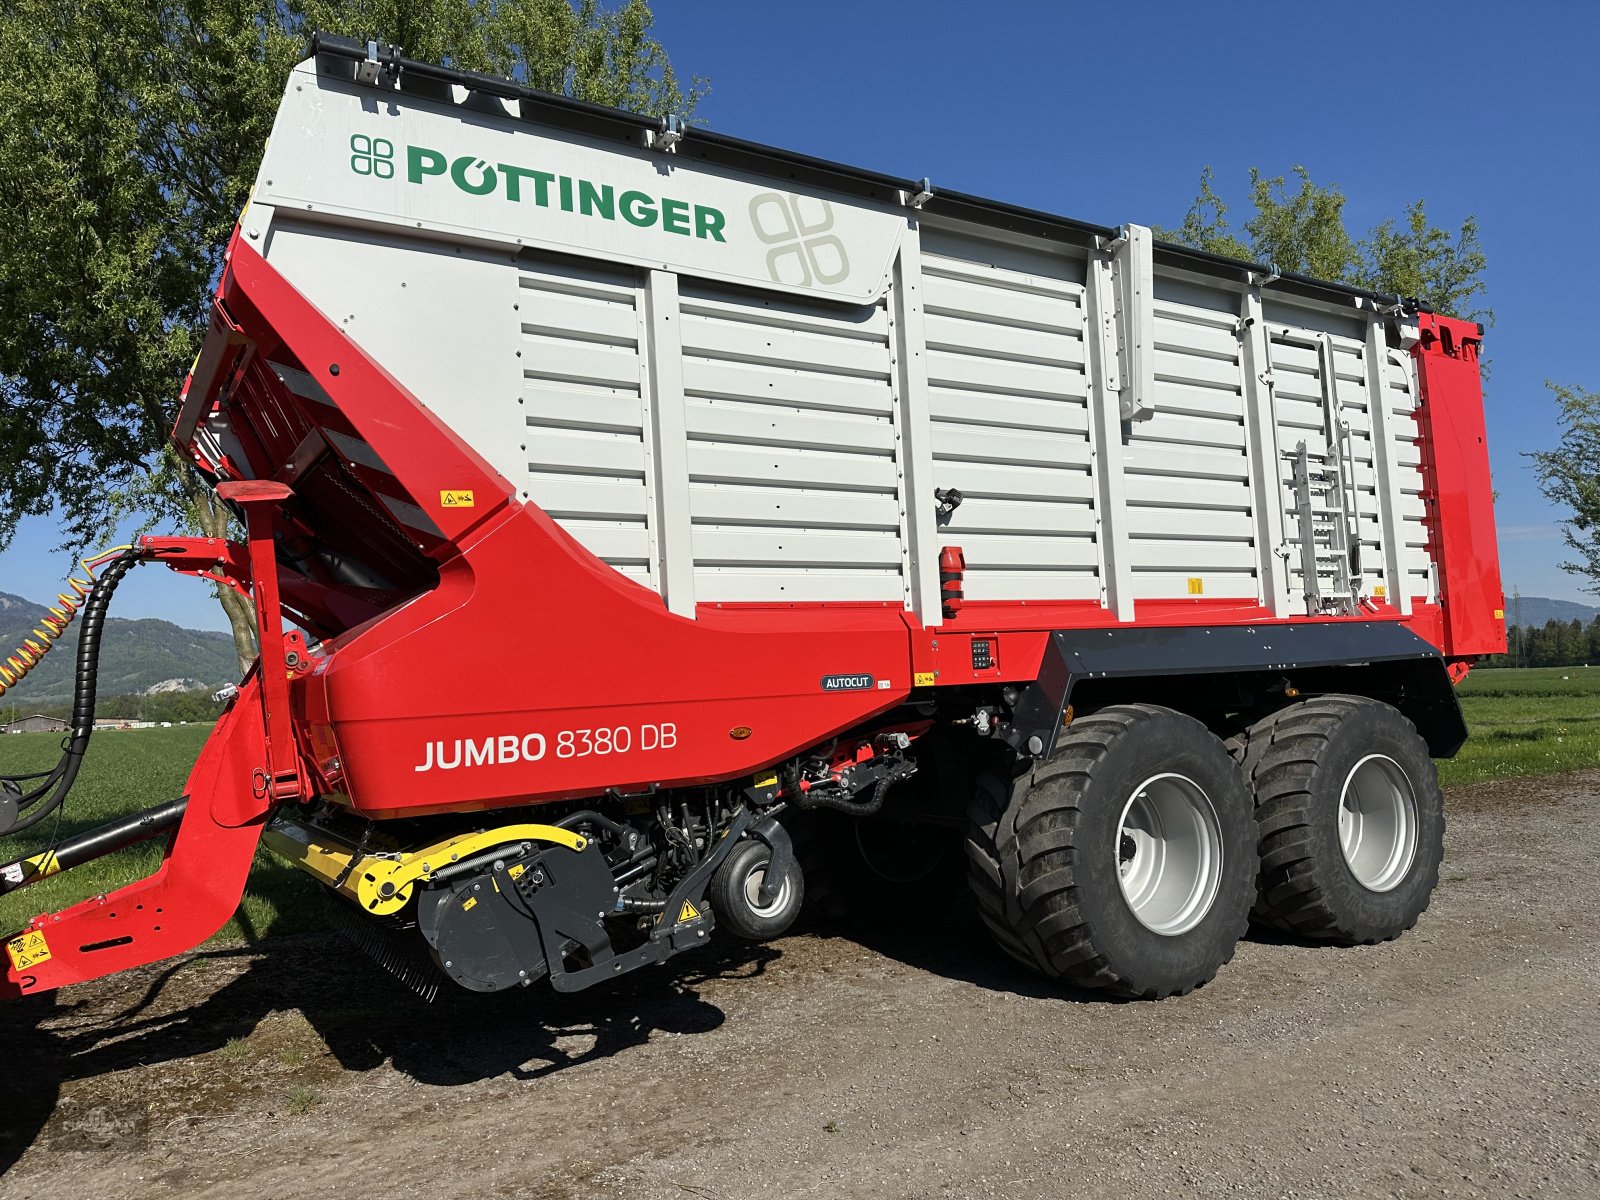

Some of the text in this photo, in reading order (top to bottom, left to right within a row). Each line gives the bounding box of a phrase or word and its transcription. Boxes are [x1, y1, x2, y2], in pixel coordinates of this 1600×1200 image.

[407, 145, 726, 243] PÖTTINGER
[826, 677, 869, 689] AUTOCUT
[414, 723, 677, 772] JUMBO 8380 DB
